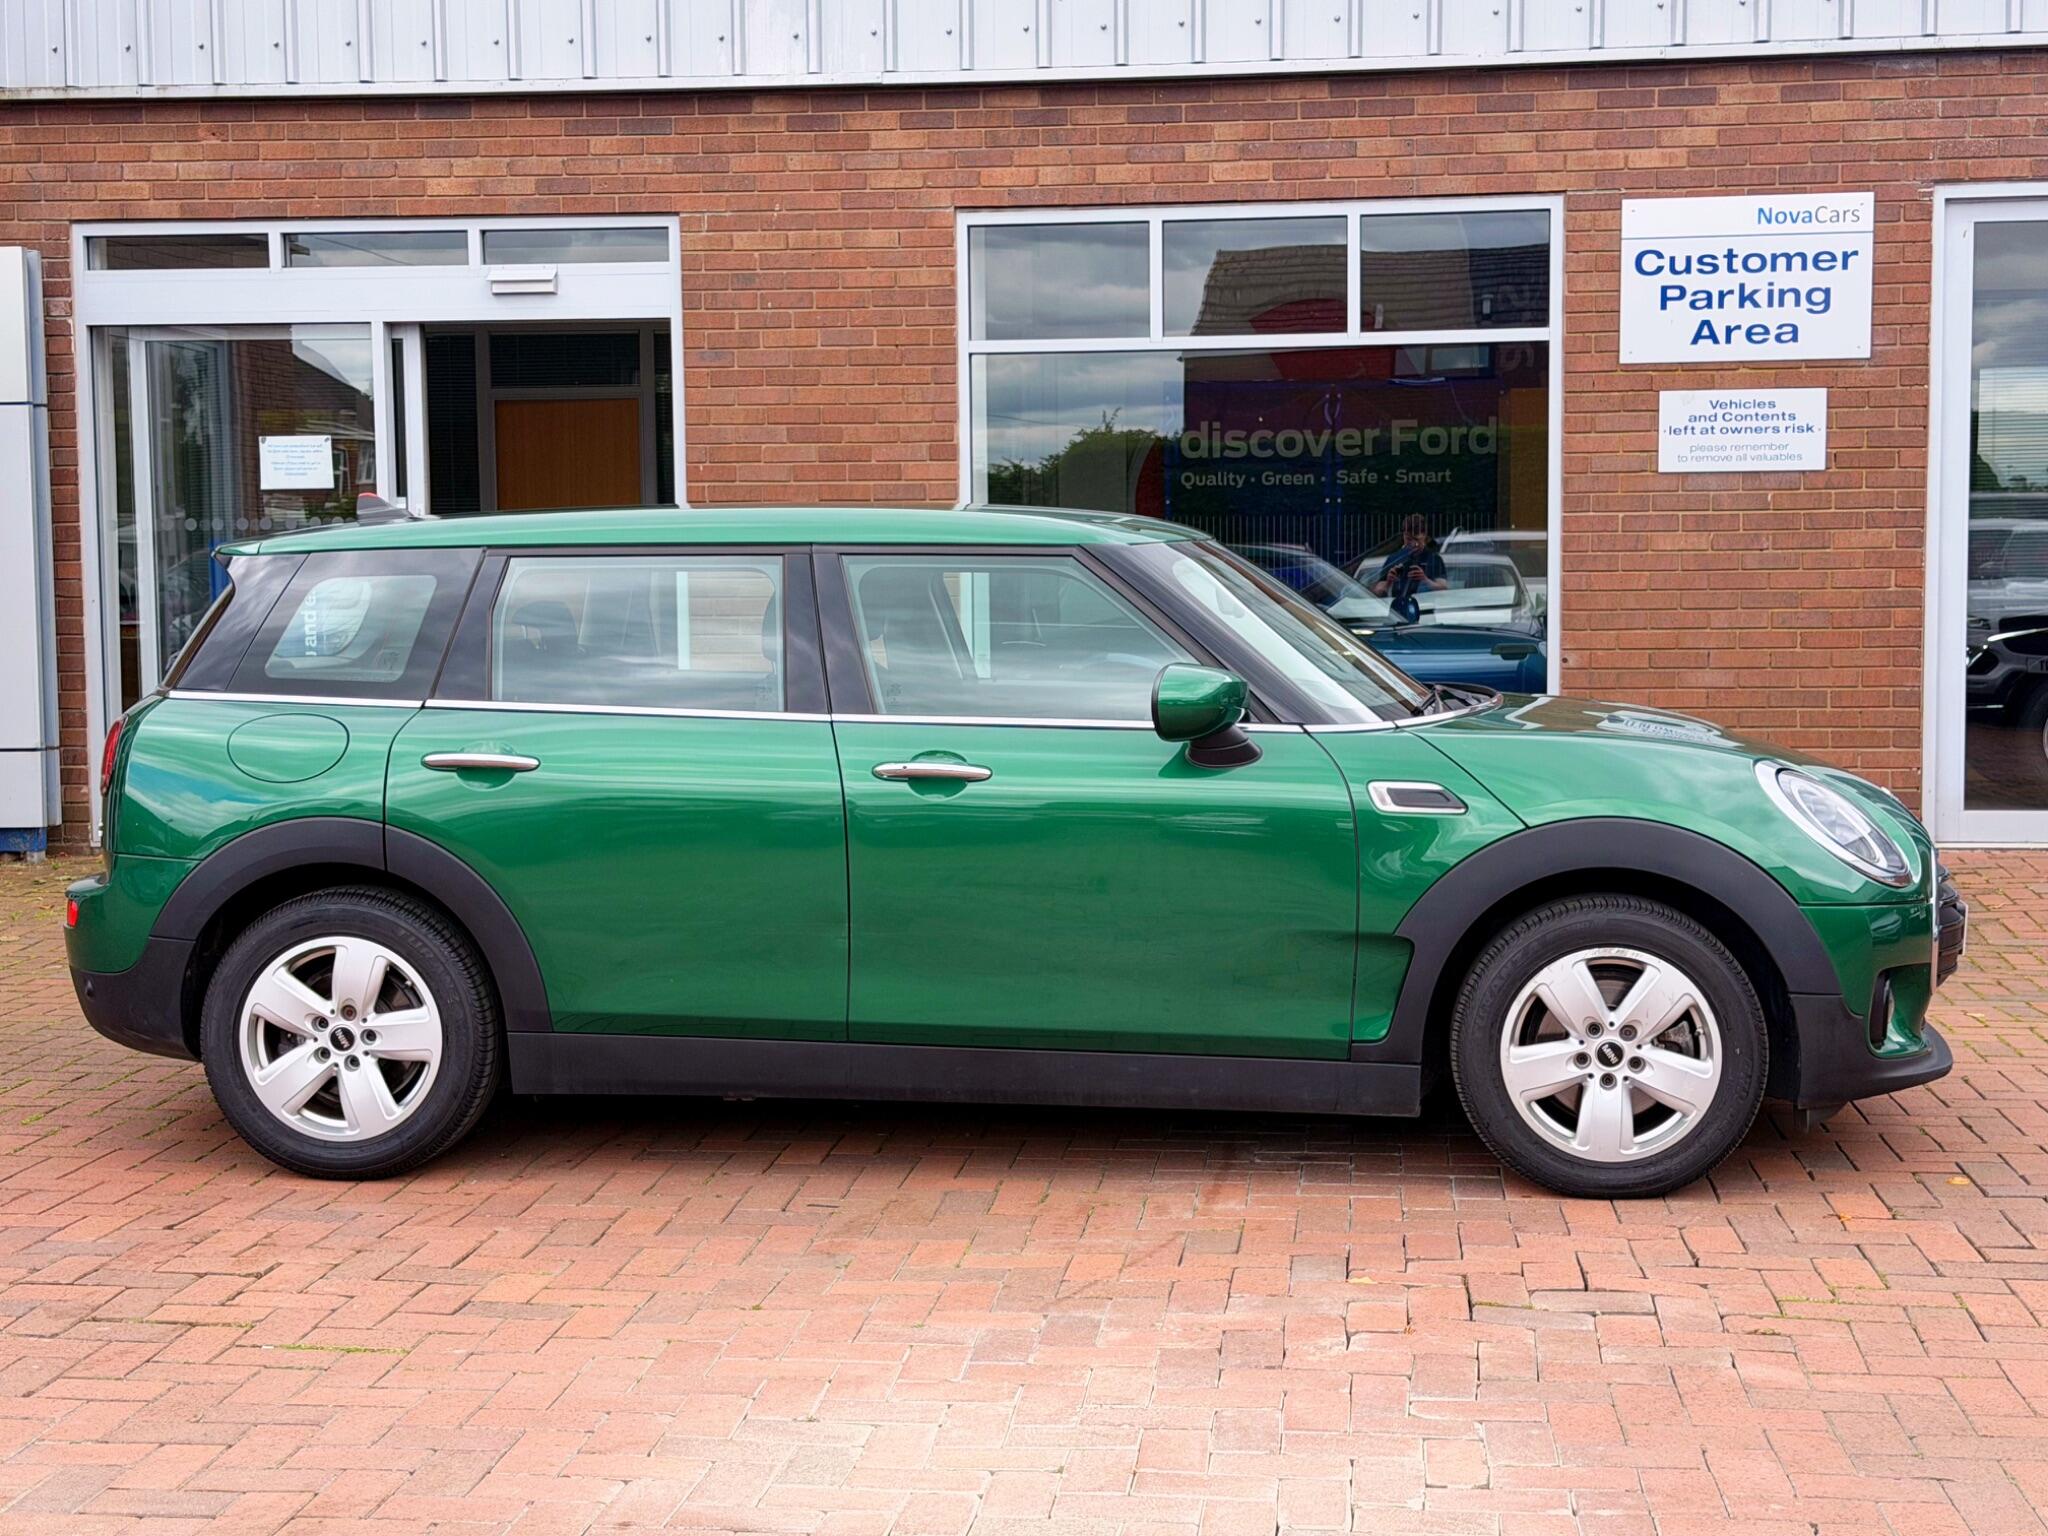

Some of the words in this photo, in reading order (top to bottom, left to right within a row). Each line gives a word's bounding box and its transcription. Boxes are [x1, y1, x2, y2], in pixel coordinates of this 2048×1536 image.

[1757, 204, 1861, 225] NovaCars
[1634, 248, 1859, 276] Customer
[1660, 281, 1832, 315] Parking
[1690, 319, 1799, 345] Area
[1709, 399, 1776, 410] Vehicles
[1687, 412, 1717, 423] and
[1721, 410, 1797, 422] Contents
[1180, 421, 1380, 459] discover
[1391, 416, 1497, 456] Ford
[1668, 425, 1696, 436] left
[1699, 425, 1715, 435] at
[1719, 424, 1780, 435] owners
[1784, 423, 1815, 434] risk
[1677, 454, 1688, 463] to
[1690, 454, 1733, 463] remove
[1735, 452, 1748, 462] all
[1750, 450, 1803, 462] valuables
[1689, 443, 1728, 454] please
[1730, 441, 1789, 452] remember
[1180, 471, 1246, 489] Quality
[1261, 471, 1315, 486] Green
[1336, 468, 1378, 484] Safe
[1395, 469, 1452, 483] Smart
[1601, 1043, 1619, 1064] MINI
